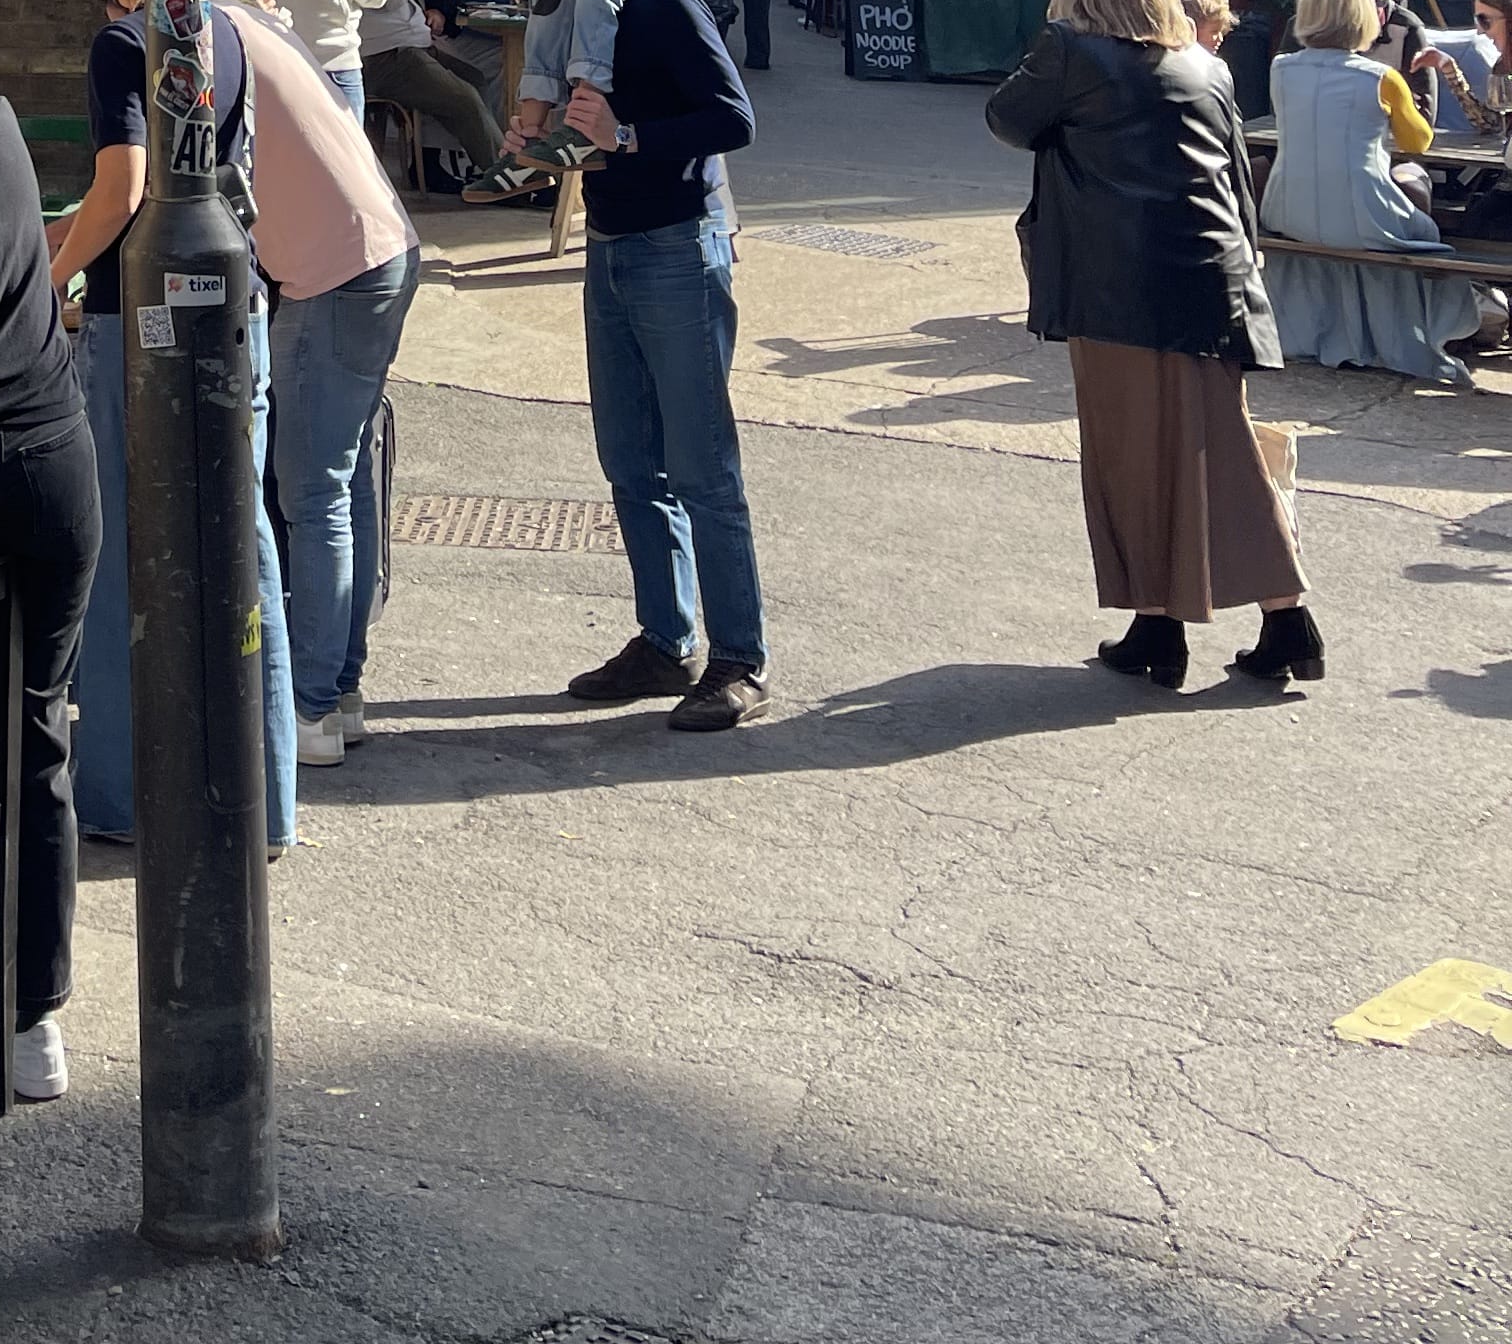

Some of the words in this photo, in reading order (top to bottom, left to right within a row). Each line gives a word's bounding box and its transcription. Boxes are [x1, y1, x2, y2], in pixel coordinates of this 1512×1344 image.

[855, 32, 916, 53] NOODLE
[864, 50, 913, 70] SOUP
[188, 276, 224, 292] tixel
